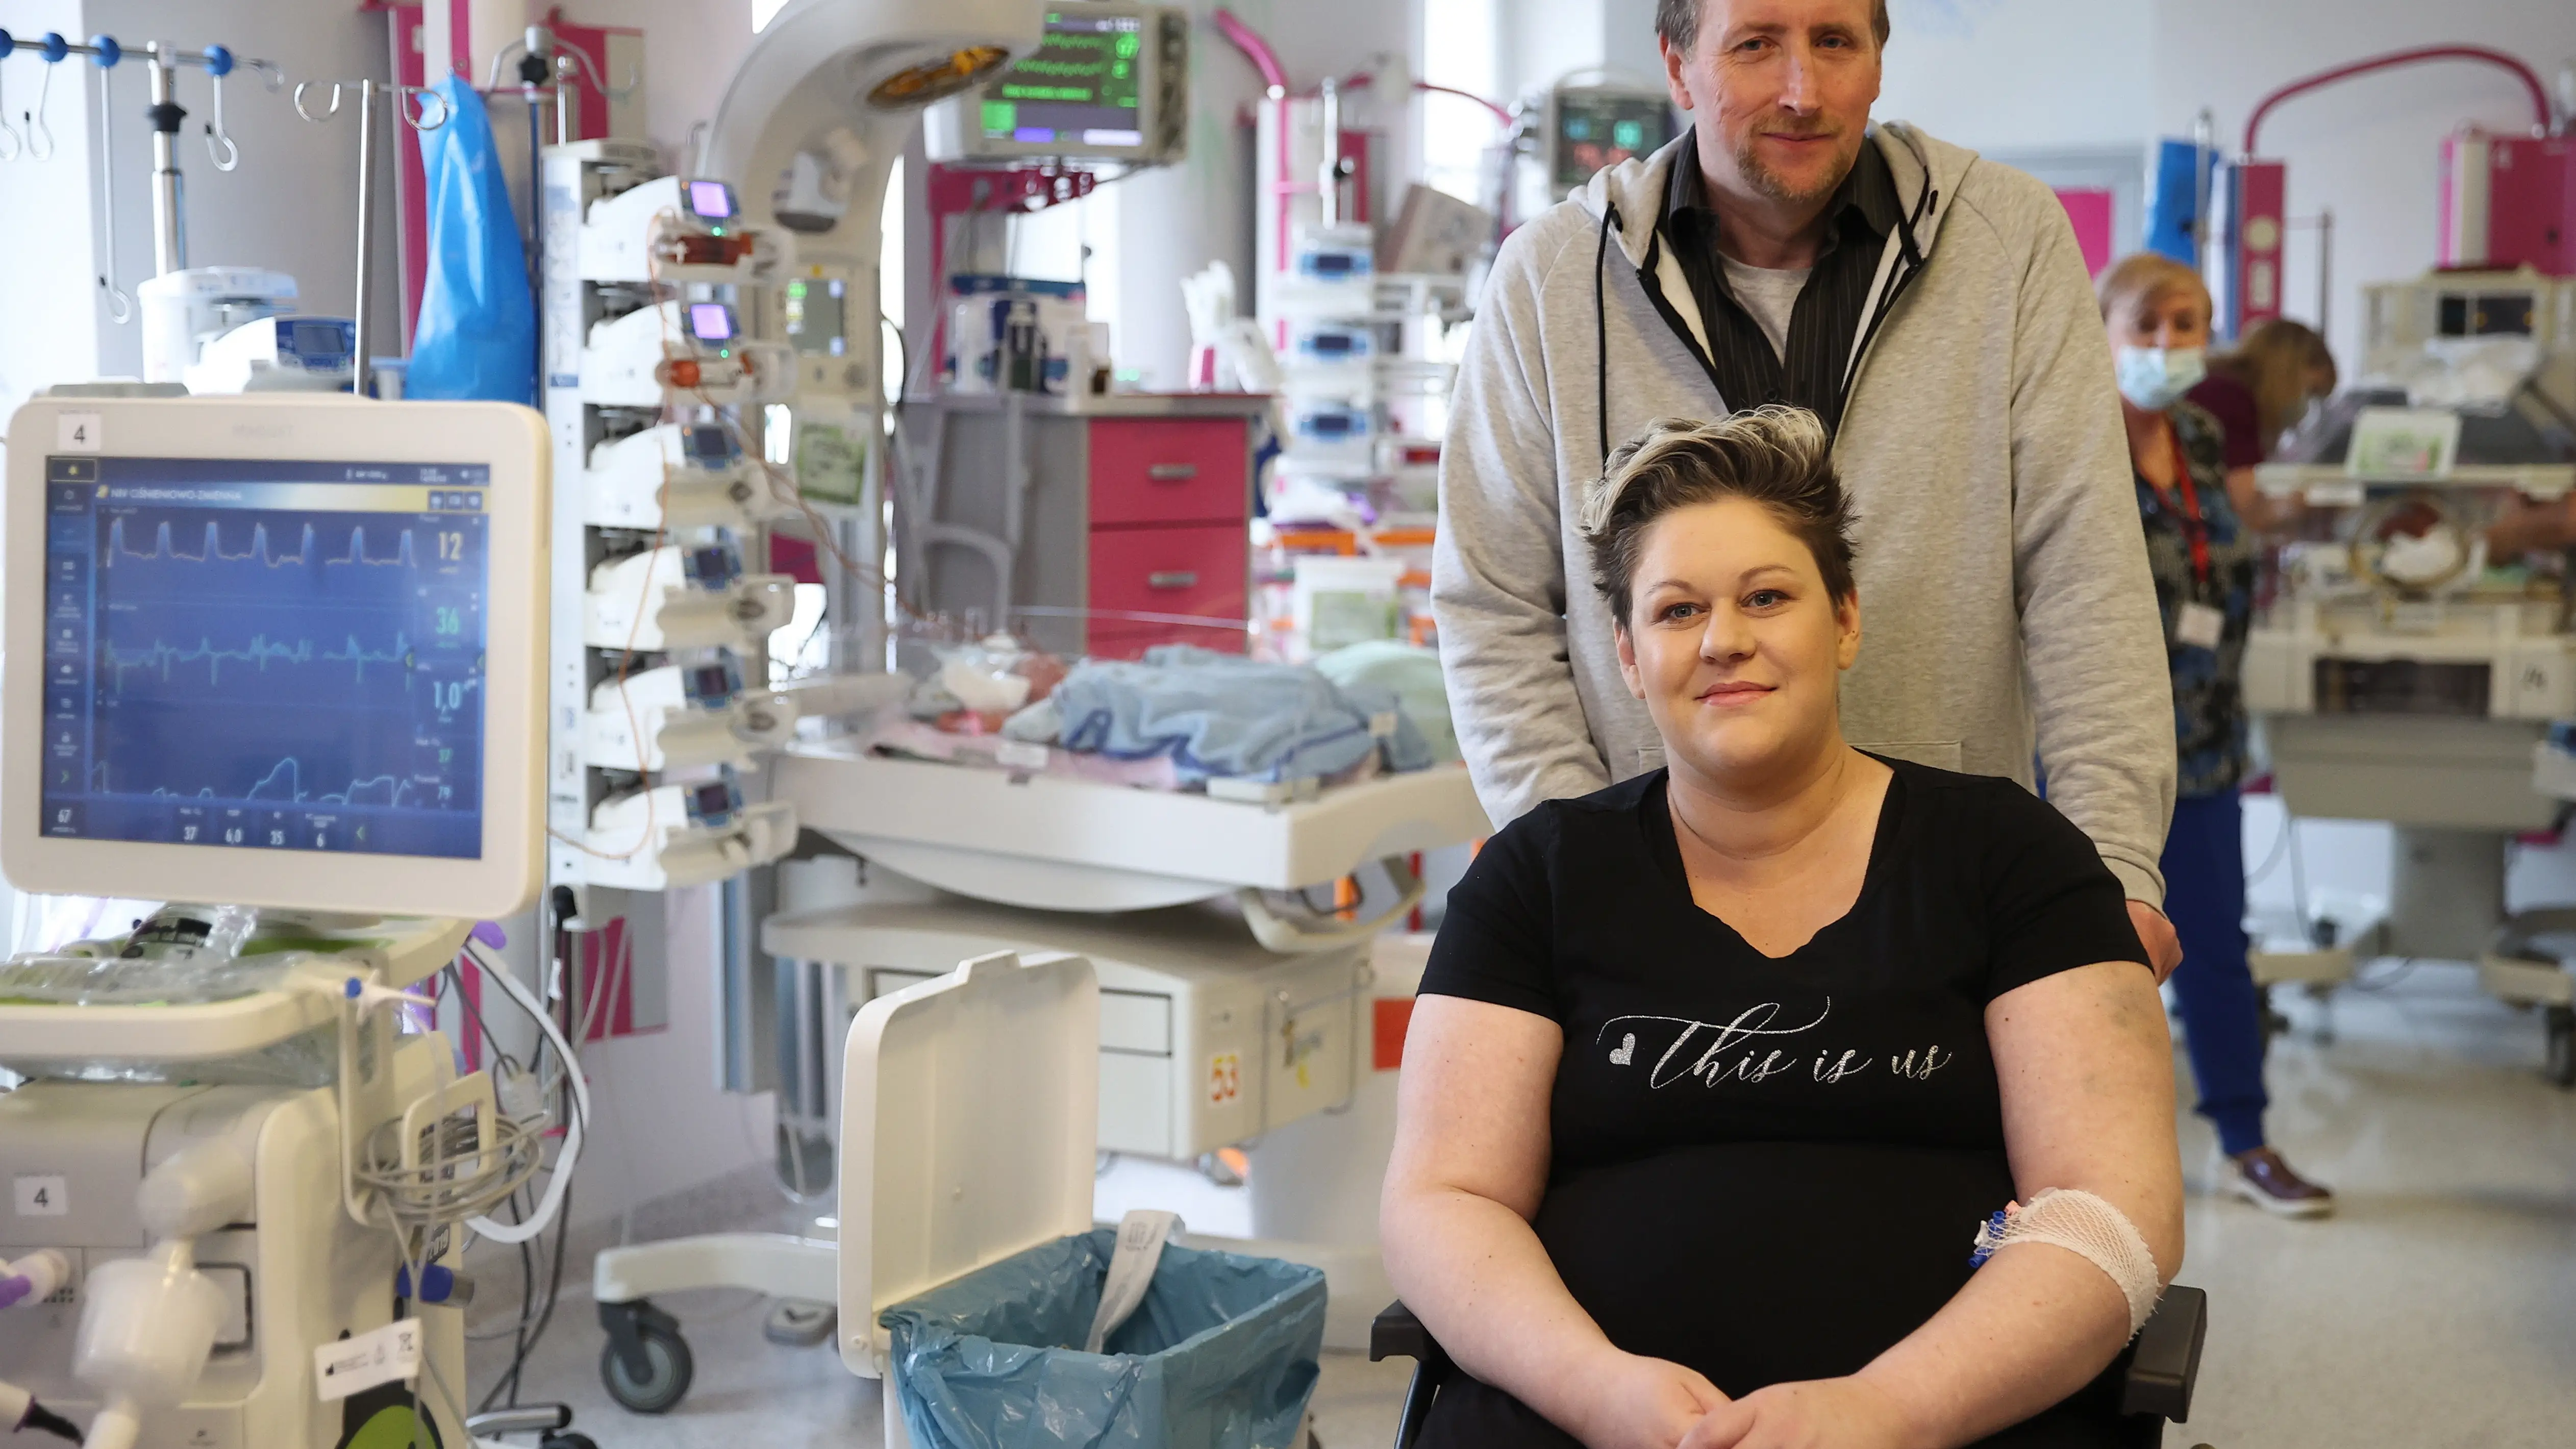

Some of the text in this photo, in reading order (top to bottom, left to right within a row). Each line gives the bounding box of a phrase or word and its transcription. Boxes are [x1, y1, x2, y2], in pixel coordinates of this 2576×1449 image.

[73, 424, 86, 444] 4
[439, 532, 463, 560] 12
[436, 607, 460, 634] 36
[184, 826, 198, 841] 37
[316, 833, 326, 848] 6
[1813, 1050, 1872, 1083] is
[1892, 1045, 1952, 1080] us
[34, 1187, 48, 1208] 4
